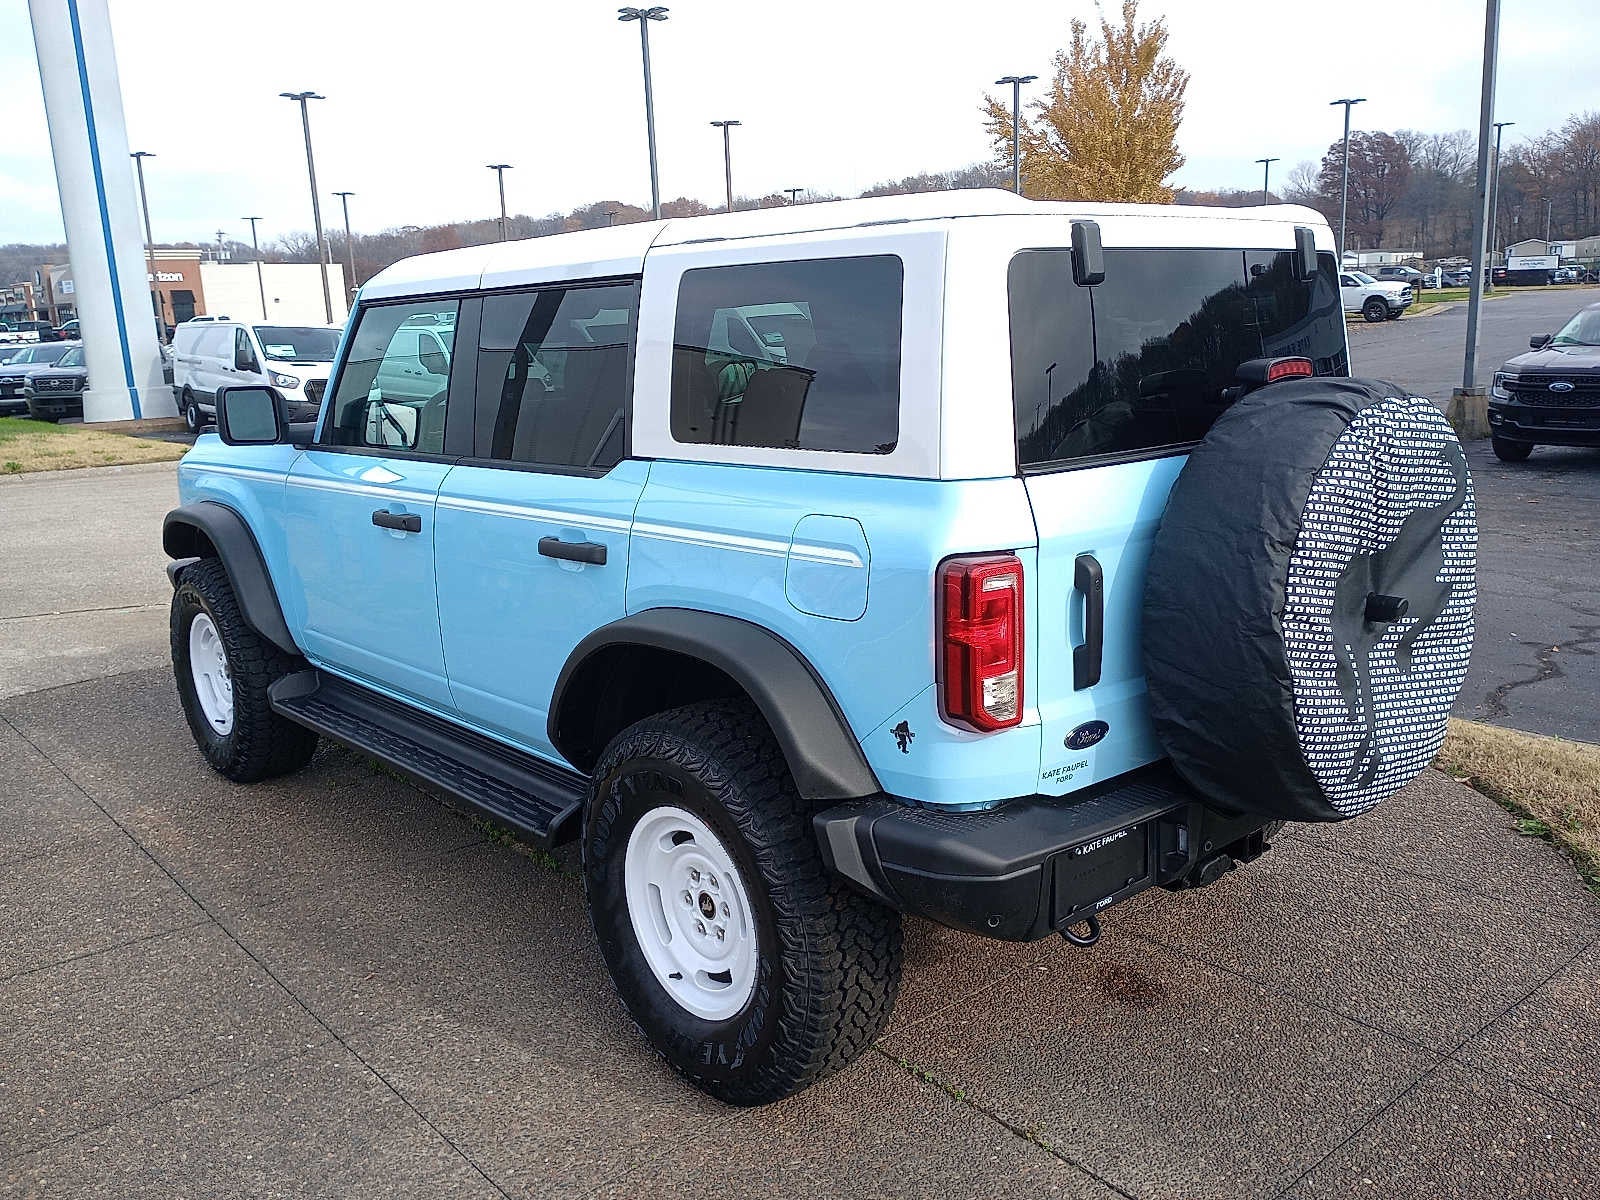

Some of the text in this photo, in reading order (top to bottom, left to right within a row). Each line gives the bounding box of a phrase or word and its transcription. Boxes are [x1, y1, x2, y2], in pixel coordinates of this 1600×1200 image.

[1042, 759, 1089, 780] KATE FAUPEL
[1056, 773, 1073, 785] FORD
[1082, 830, 1128, 855] KATE FAUPEL
[1096, 896, 1113, 910] FORD
